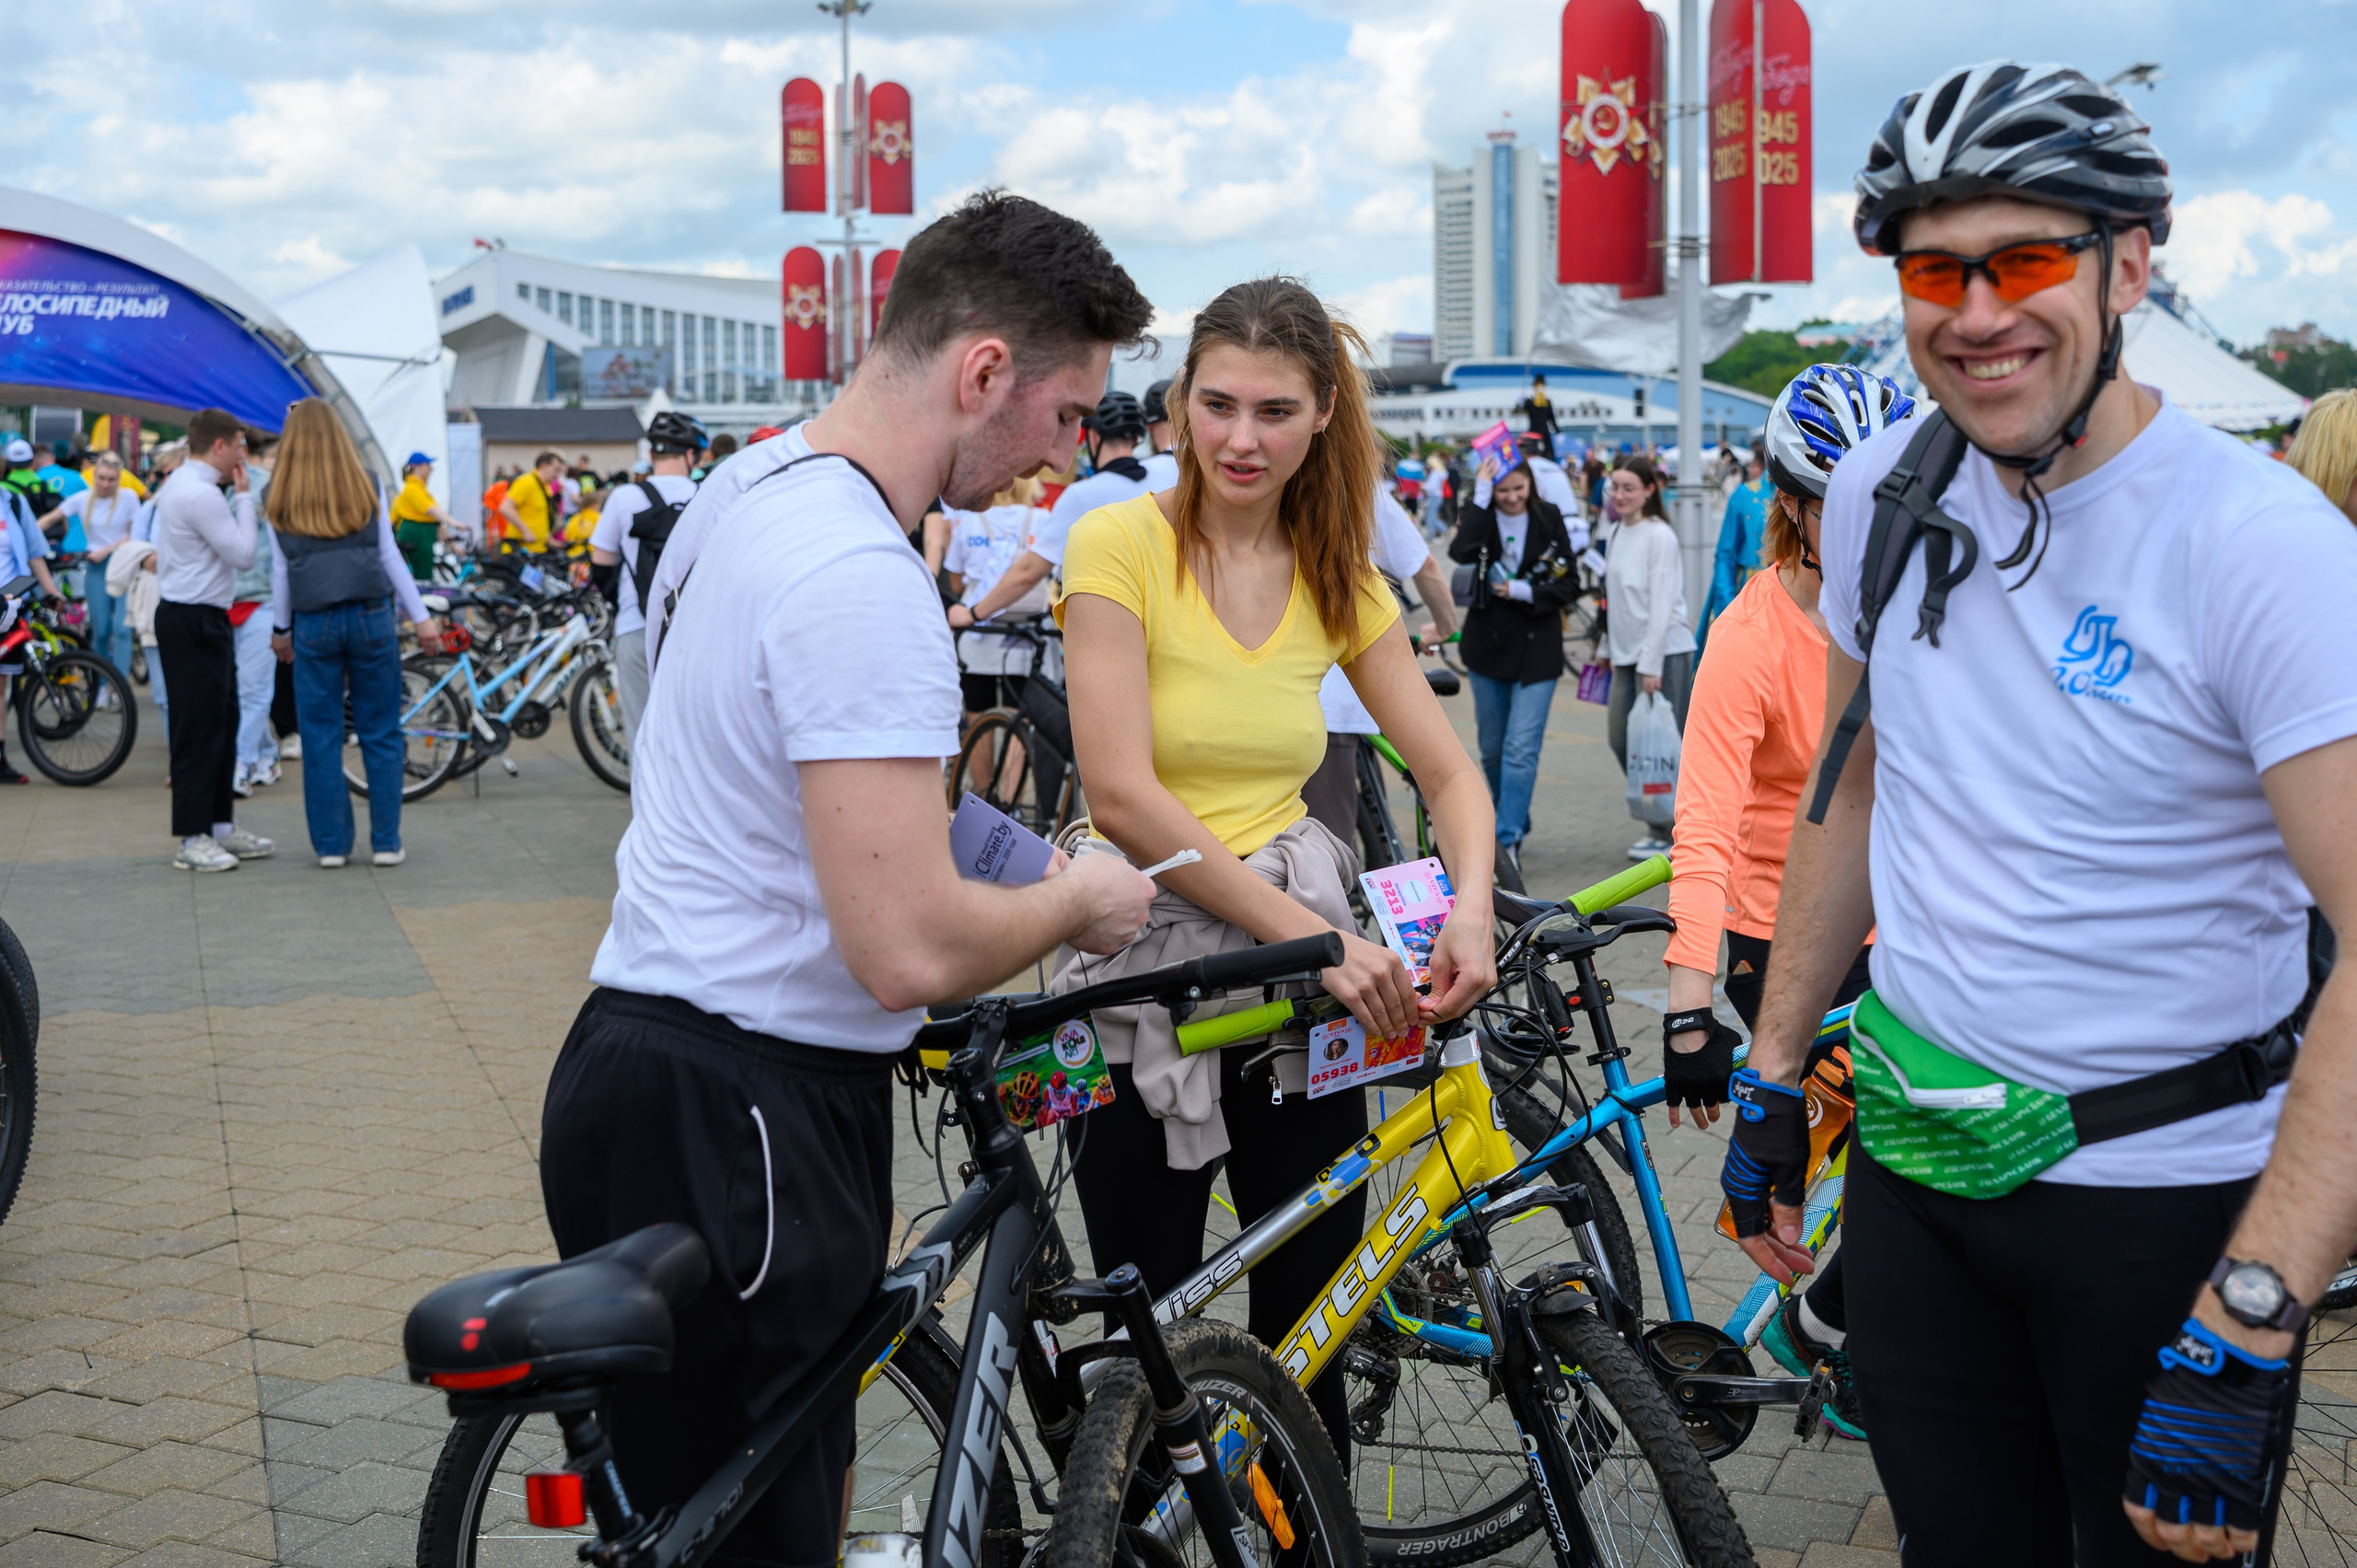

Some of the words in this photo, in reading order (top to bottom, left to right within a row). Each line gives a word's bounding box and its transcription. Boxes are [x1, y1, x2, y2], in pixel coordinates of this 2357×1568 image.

[1714, 99, 1746, 138] 1945
[1759, 109, 1799, 145] 945
[1759, 151, 1799, 185] 025
[0, 292, 169, 320] ЛОСИПЕДНЫЙ
[0, 313, 36, 335] УБ
[973, 820, 1012, 877] iClimate.by
[1380, 879, 1404, 915] 3213
[1059, 1029, 1079, 1042] VIVA
[1311, 1062, 1359, 1085] 05938
[1276, 1181, 1429, 1379] STELS
[1190, 1378, 1248, 1399] RUZER
[923, 1311, 1017, 1568] ZER
[1397, 1512, 1512, 1556] BONTRAGER
